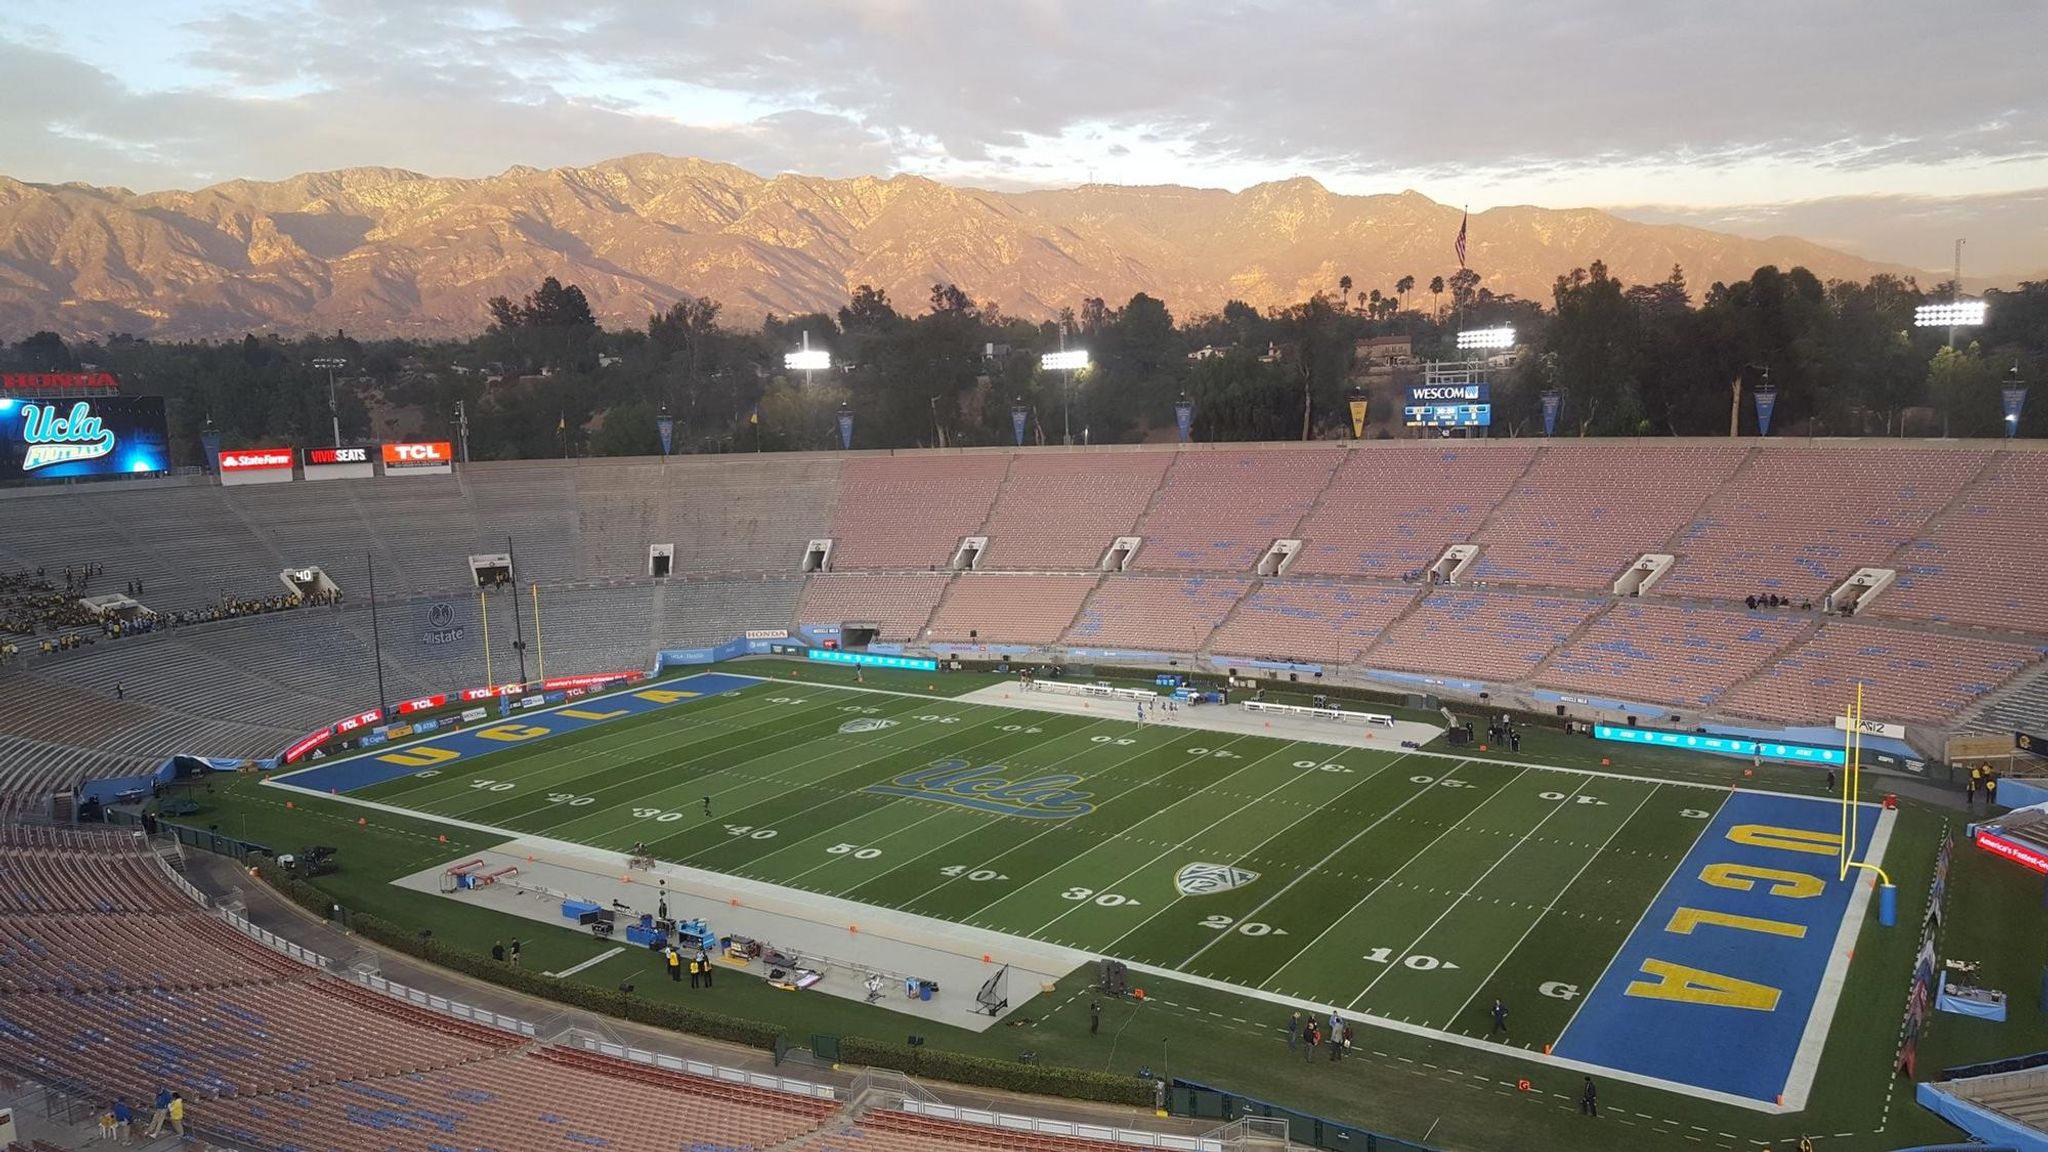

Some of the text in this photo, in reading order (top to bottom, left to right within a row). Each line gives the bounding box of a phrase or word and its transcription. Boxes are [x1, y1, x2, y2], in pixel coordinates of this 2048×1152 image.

[1413, 387, 1464, 399] WESCOM
[395, 445, 440, 460] TCL
[295, 570, 311, 580] 40
[423, 629, 464, 644] Allstate
[747, 629, 786, 638] HONDA
[469, 688, 493, 699] TCL
[567, 688, 584, 697] TCL
[411, 699, 434, 710] TCL
[361, 712, 379, 723] TCL
[341, 720, 359, 731] TCL
[632, 807, 684, 822] 30
[723, 823, 778, 840] 40
[826, 843, 882, 860] 50
[1980, 837, 2012, 854] America's
[940, 864, 998, 882] 40
[1061, 886, 1127, 906] 30
[1198, 914, 1272, 936] 20
[1362, 946, 1440, 971] 10
[1538, 980, 1580, 1001] G
